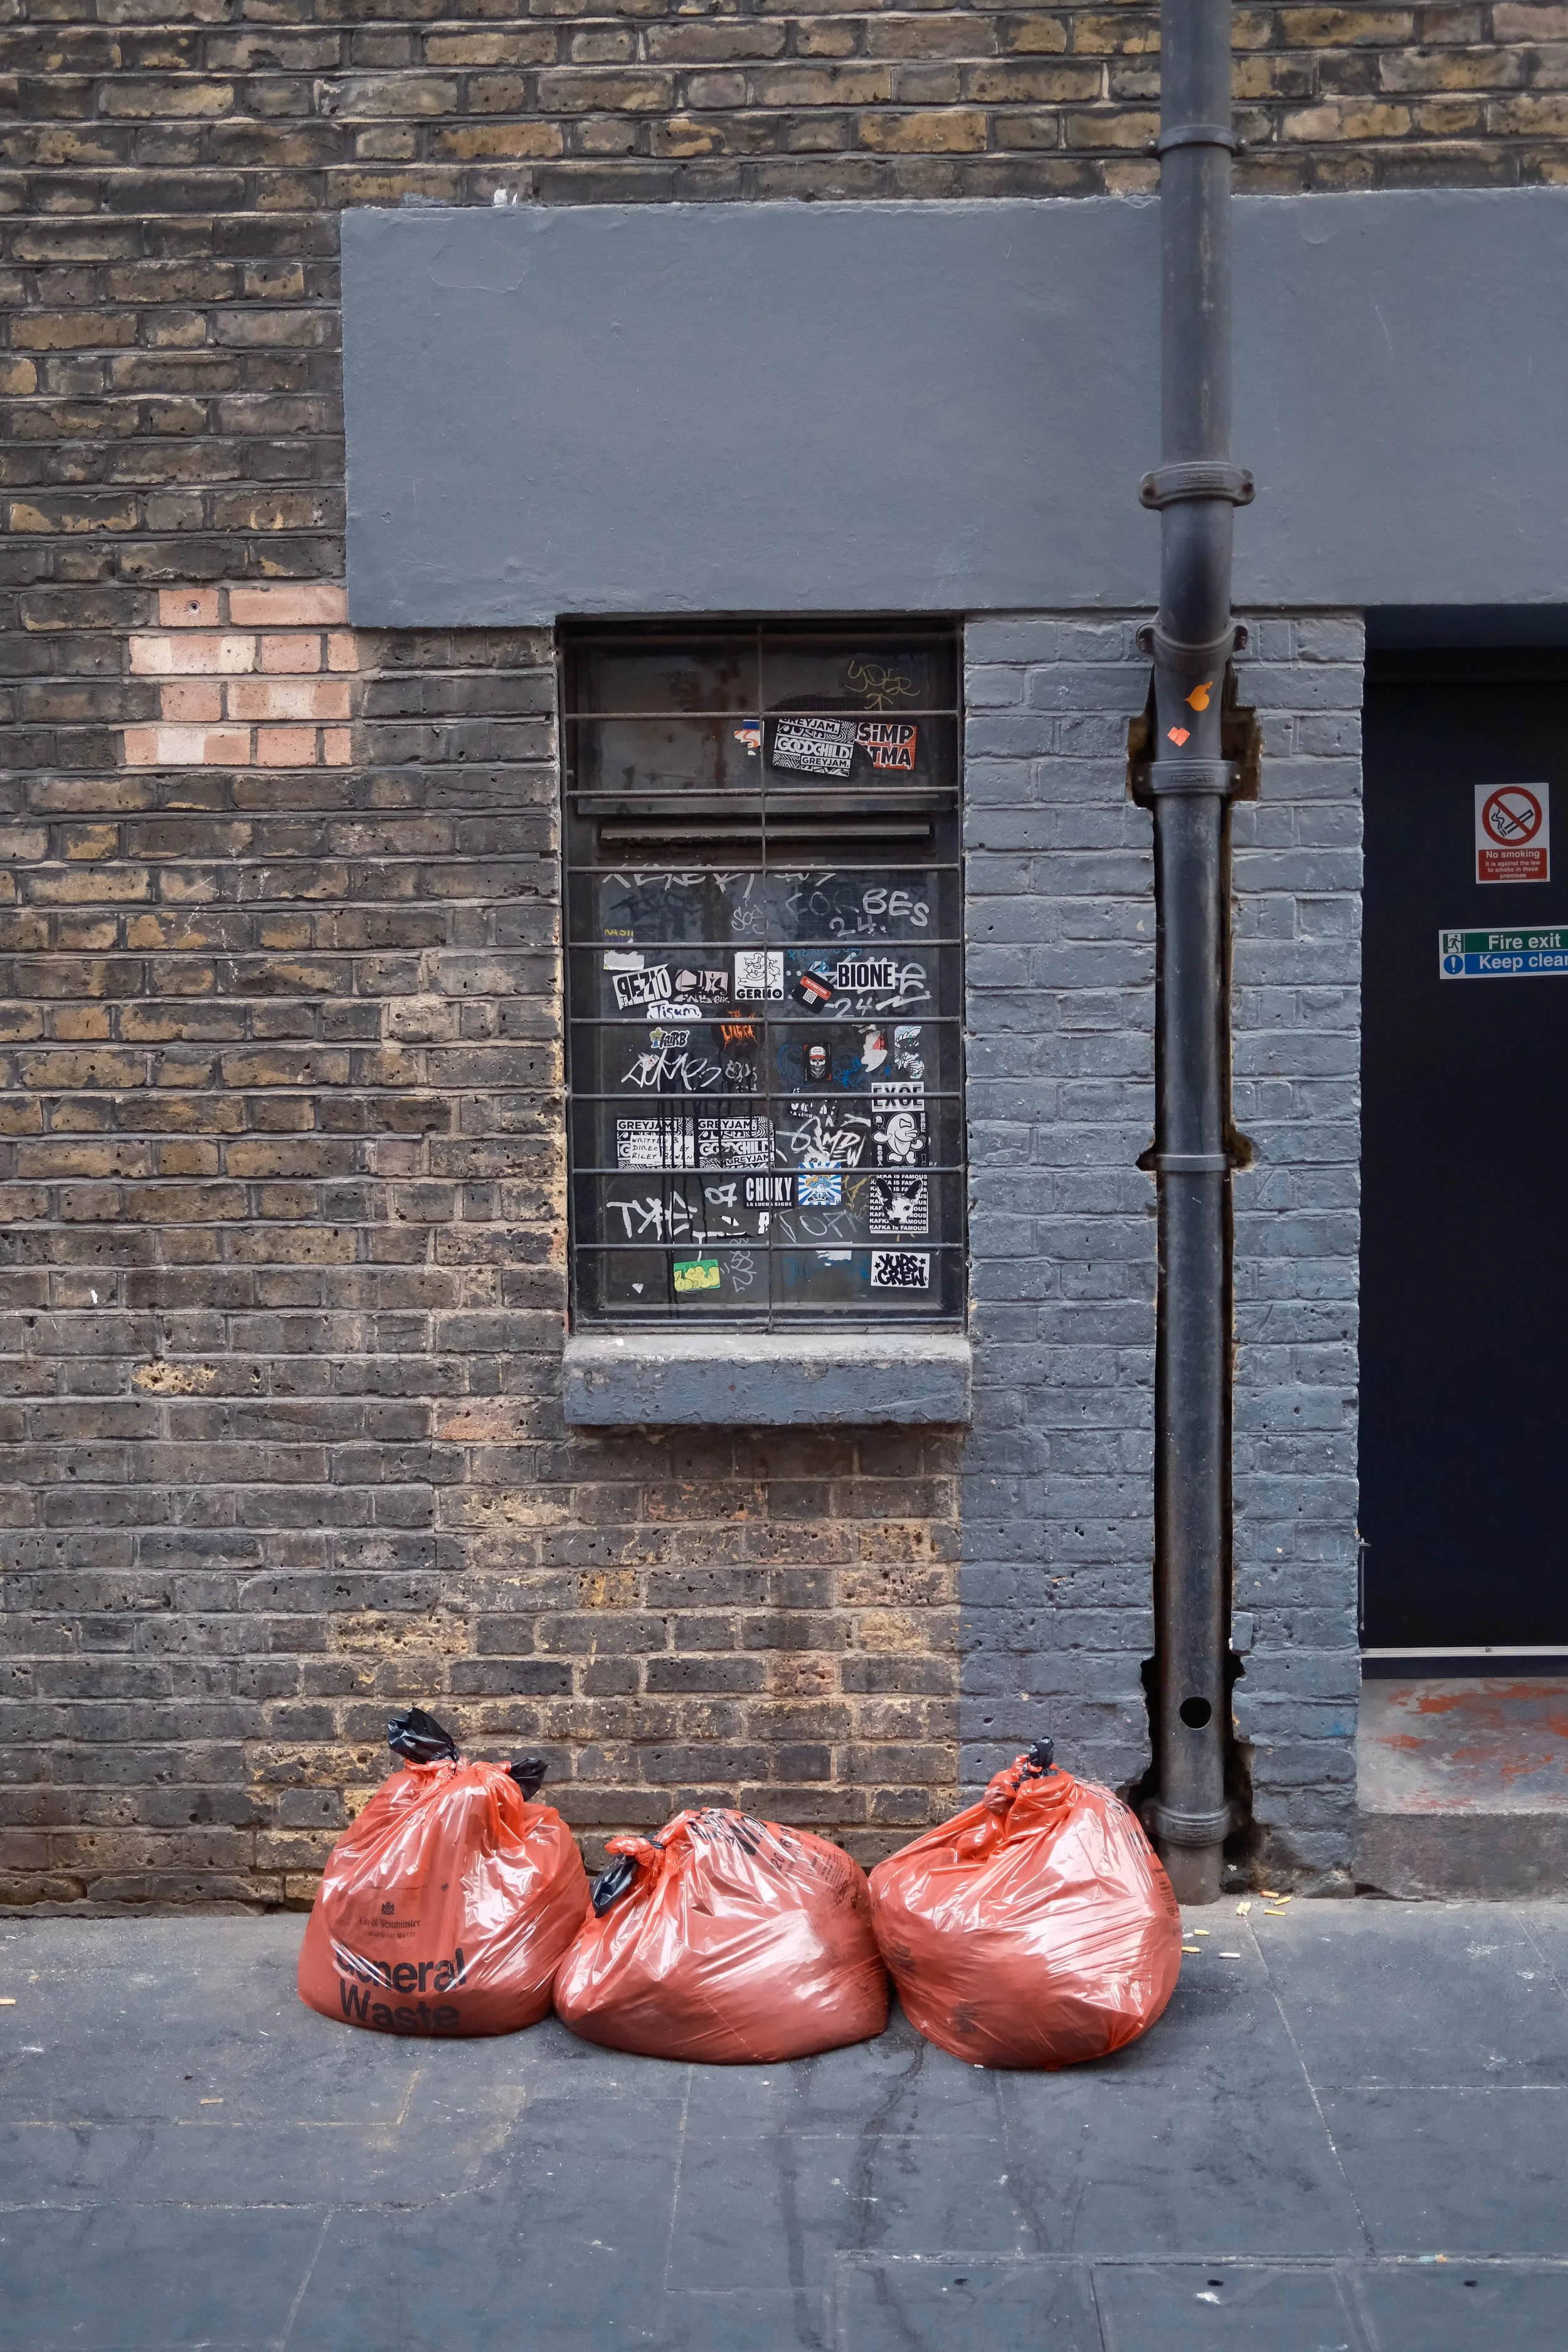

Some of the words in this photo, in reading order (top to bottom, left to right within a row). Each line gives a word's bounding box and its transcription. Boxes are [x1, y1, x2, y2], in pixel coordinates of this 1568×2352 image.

[802, 756, 849, 767] GREYJAM.
[1486, 850, 1498, 859] No
[1501, 849, 1540, 859] smoking
[1488, 935, 1523, 950] Fire
[1528, 933, 1561, 948] exit
[1479, 955, 1523, 972] Keep
[839, 964, 893, 987] BIONE
[746, 1177, 792, 1201] CHUKY
[877, 1266, 926, 1287] CREW
[371, 1919, 378, 1927] of
[379, 1919, 421, 1929] Westminster
[340, 1978, 460, 2031] Waste
